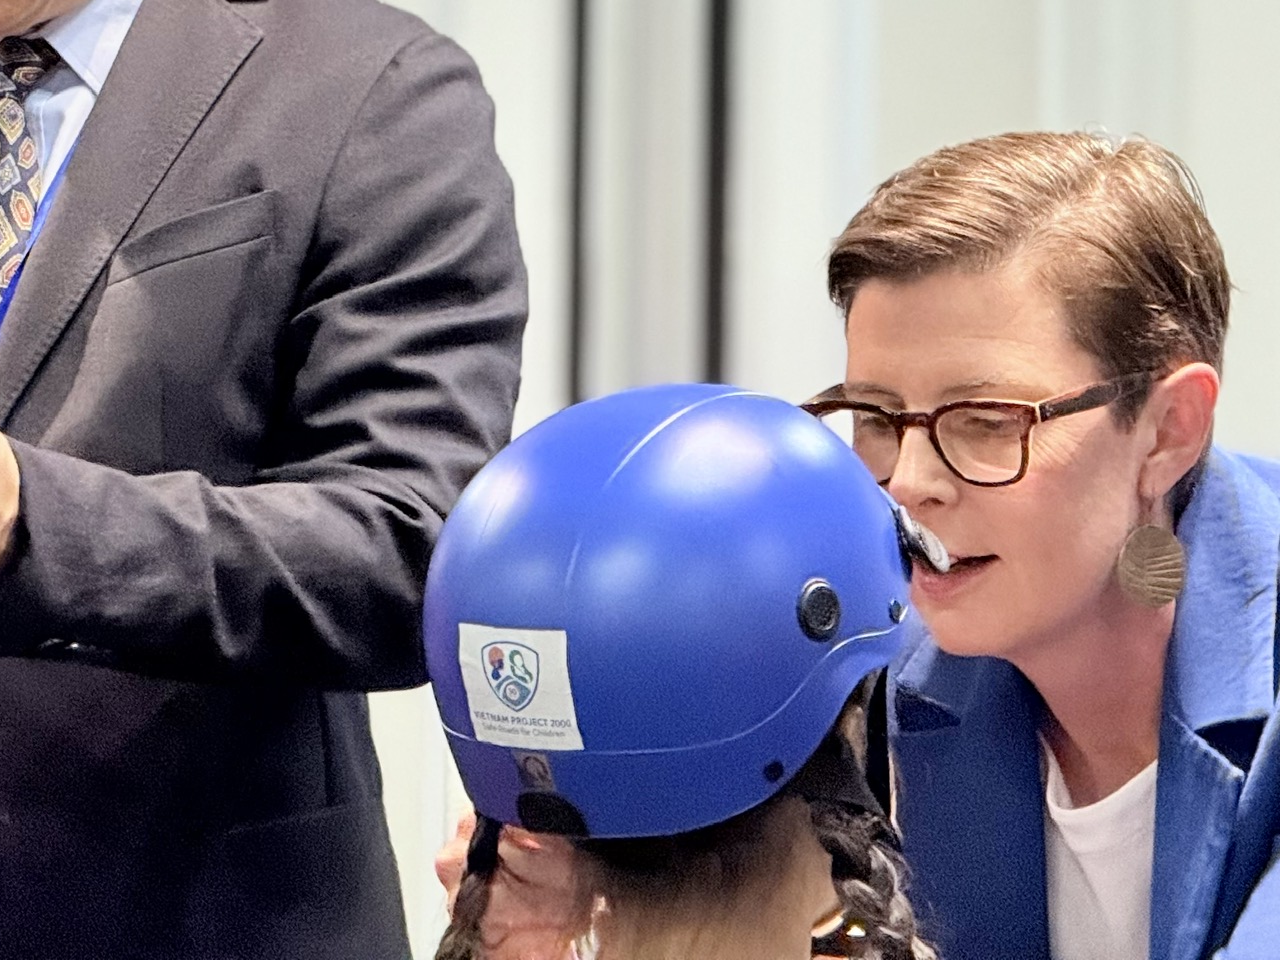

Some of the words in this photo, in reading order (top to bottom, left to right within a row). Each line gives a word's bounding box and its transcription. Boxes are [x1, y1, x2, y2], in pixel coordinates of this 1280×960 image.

[473, 711, 509, 723] VIETNAM
[510, 716, 548, 727] PROJECT
[532, 728, 566, 737] Children
